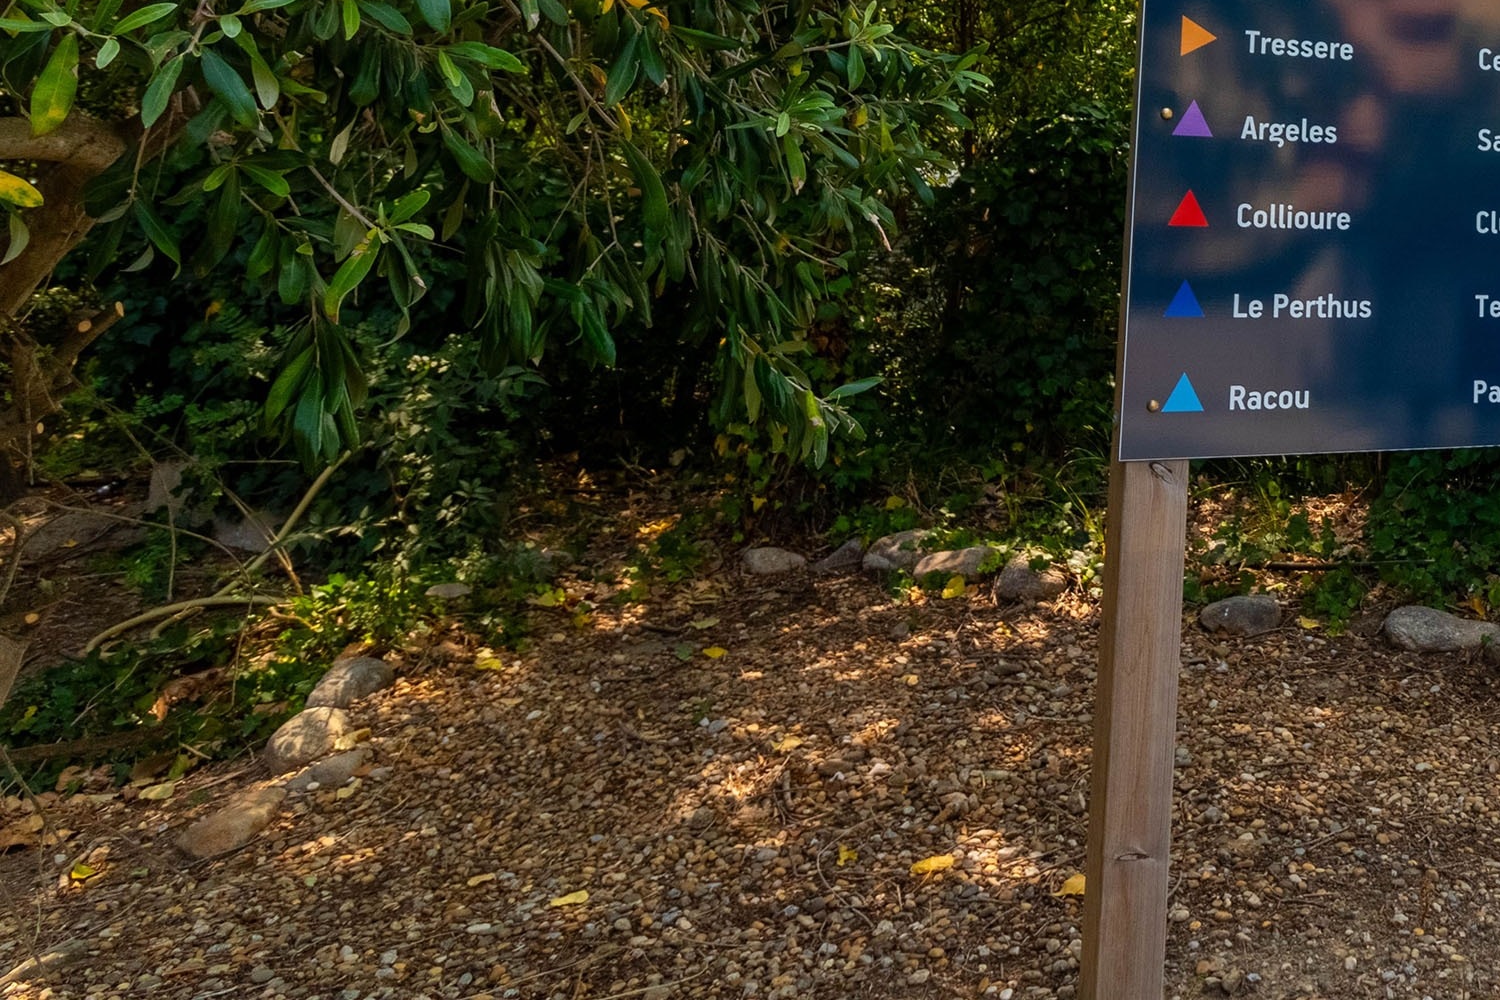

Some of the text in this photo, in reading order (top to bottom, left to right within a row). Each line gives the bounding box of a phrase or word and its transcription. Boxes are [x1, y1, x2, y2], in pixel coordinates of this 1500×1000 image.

[1245, 30, 1353, 60] Tressere
[1241, 116, 1337, 148] Argeles
[1237, 203, 1351, 230] Collioure
[1233, 293, 1372, 318] Le Perthus
[1229, 385, 1309, 410] Racou
